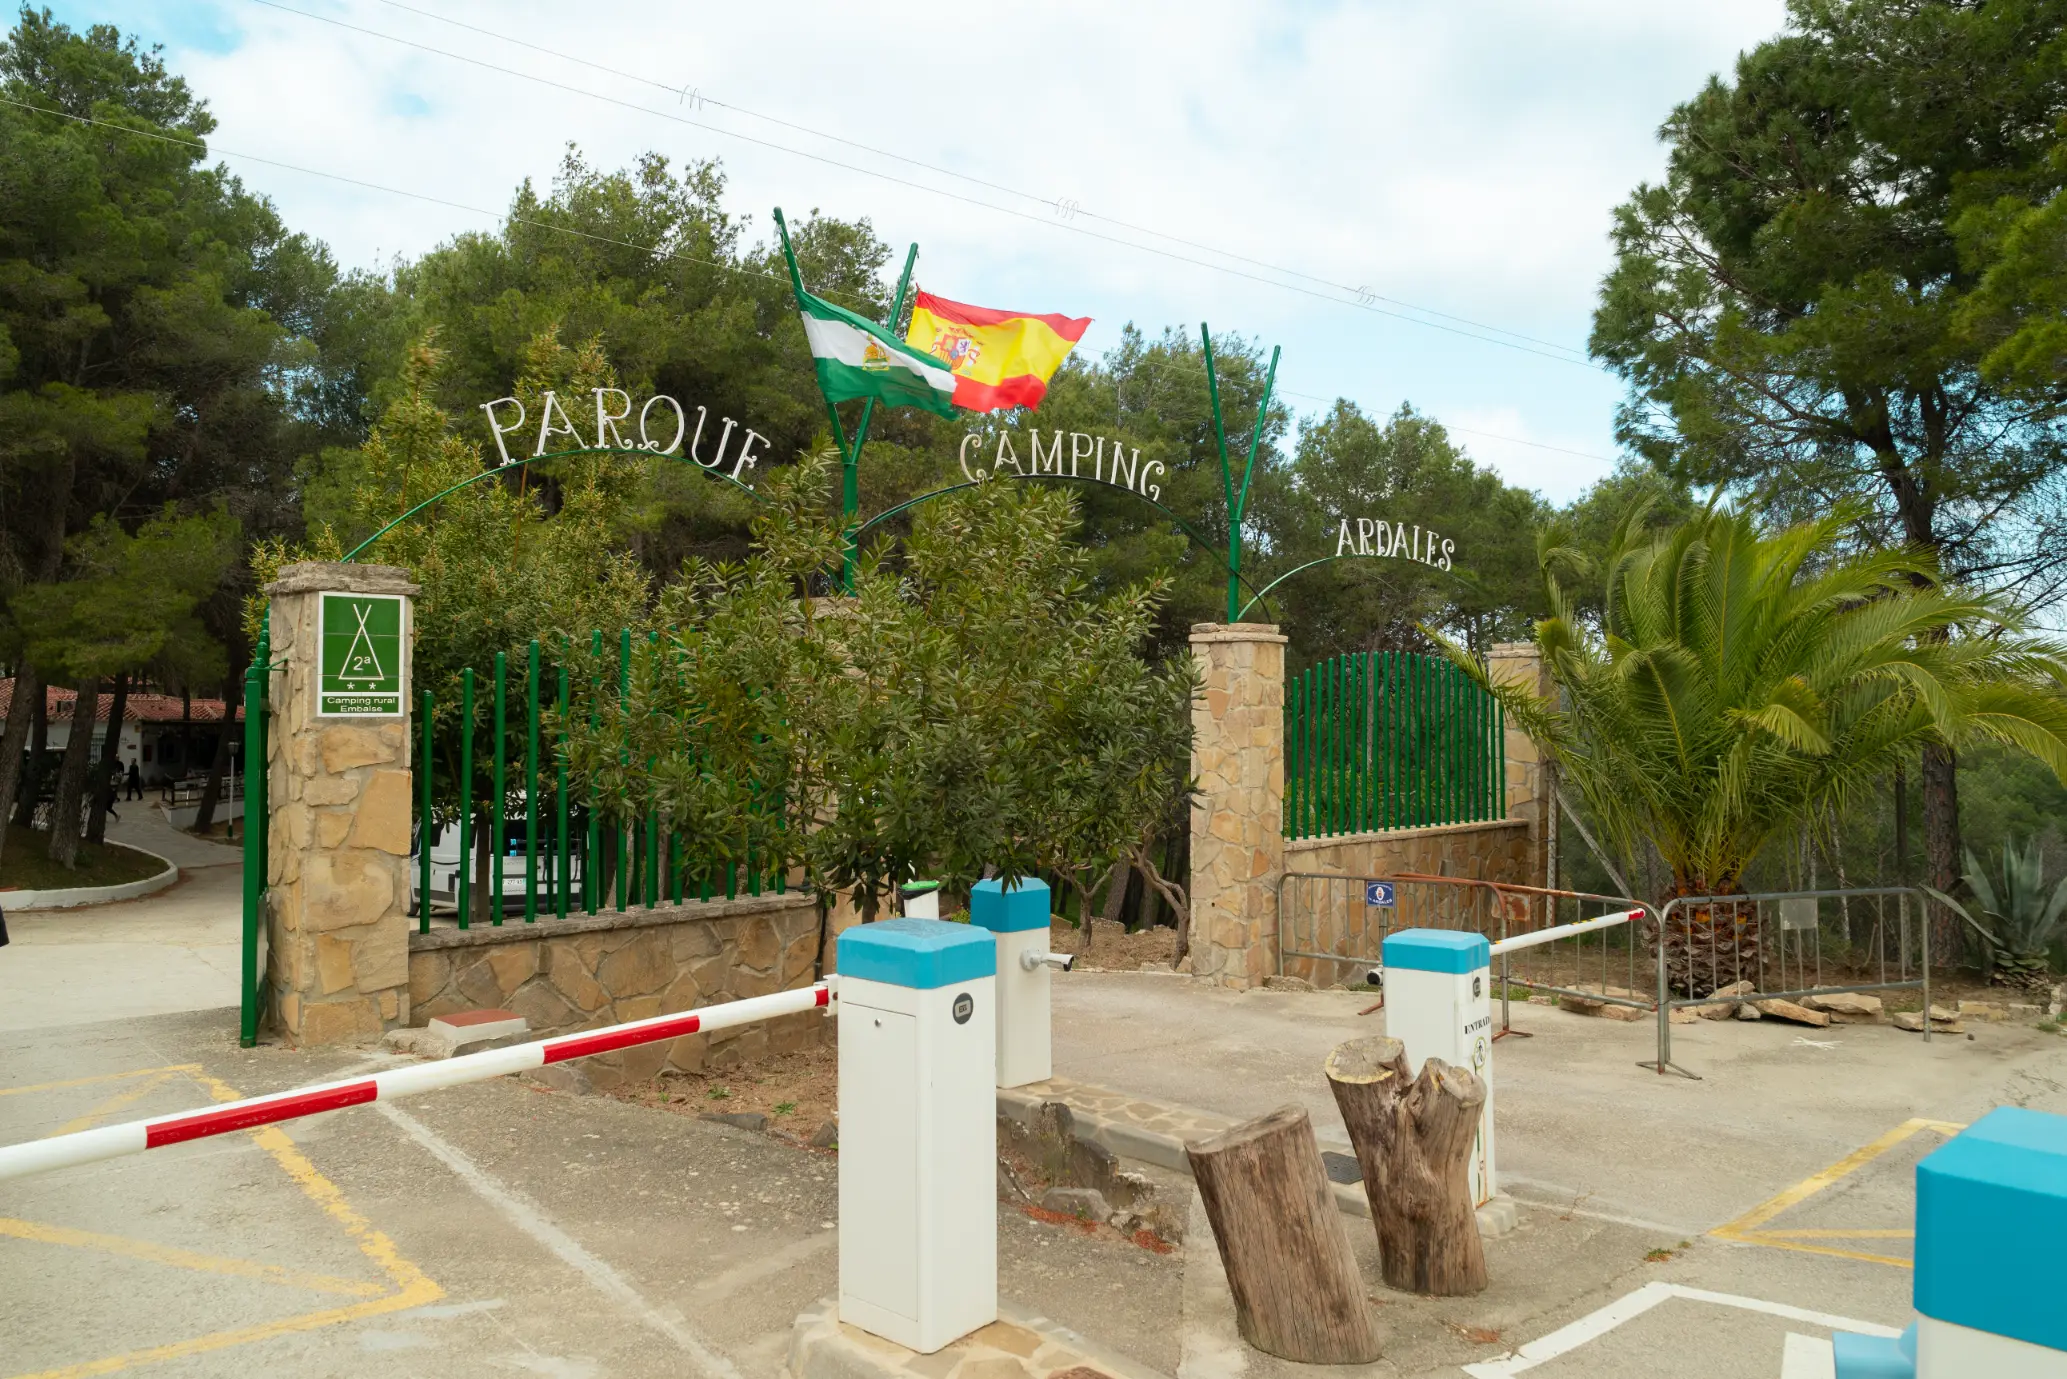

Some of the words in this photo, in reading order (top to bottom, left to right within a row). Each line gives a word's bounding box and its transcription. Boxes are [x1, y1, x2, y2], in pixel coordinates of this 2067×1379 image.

[479, 387, 771, 491] PARQUE
[960, 428, 1165, 501] CAMPING
[1336, 518, 1455, 572] ARDALES
[327, 697, 371, 705] Camping
[340, 705, 383, 713] Embalse
